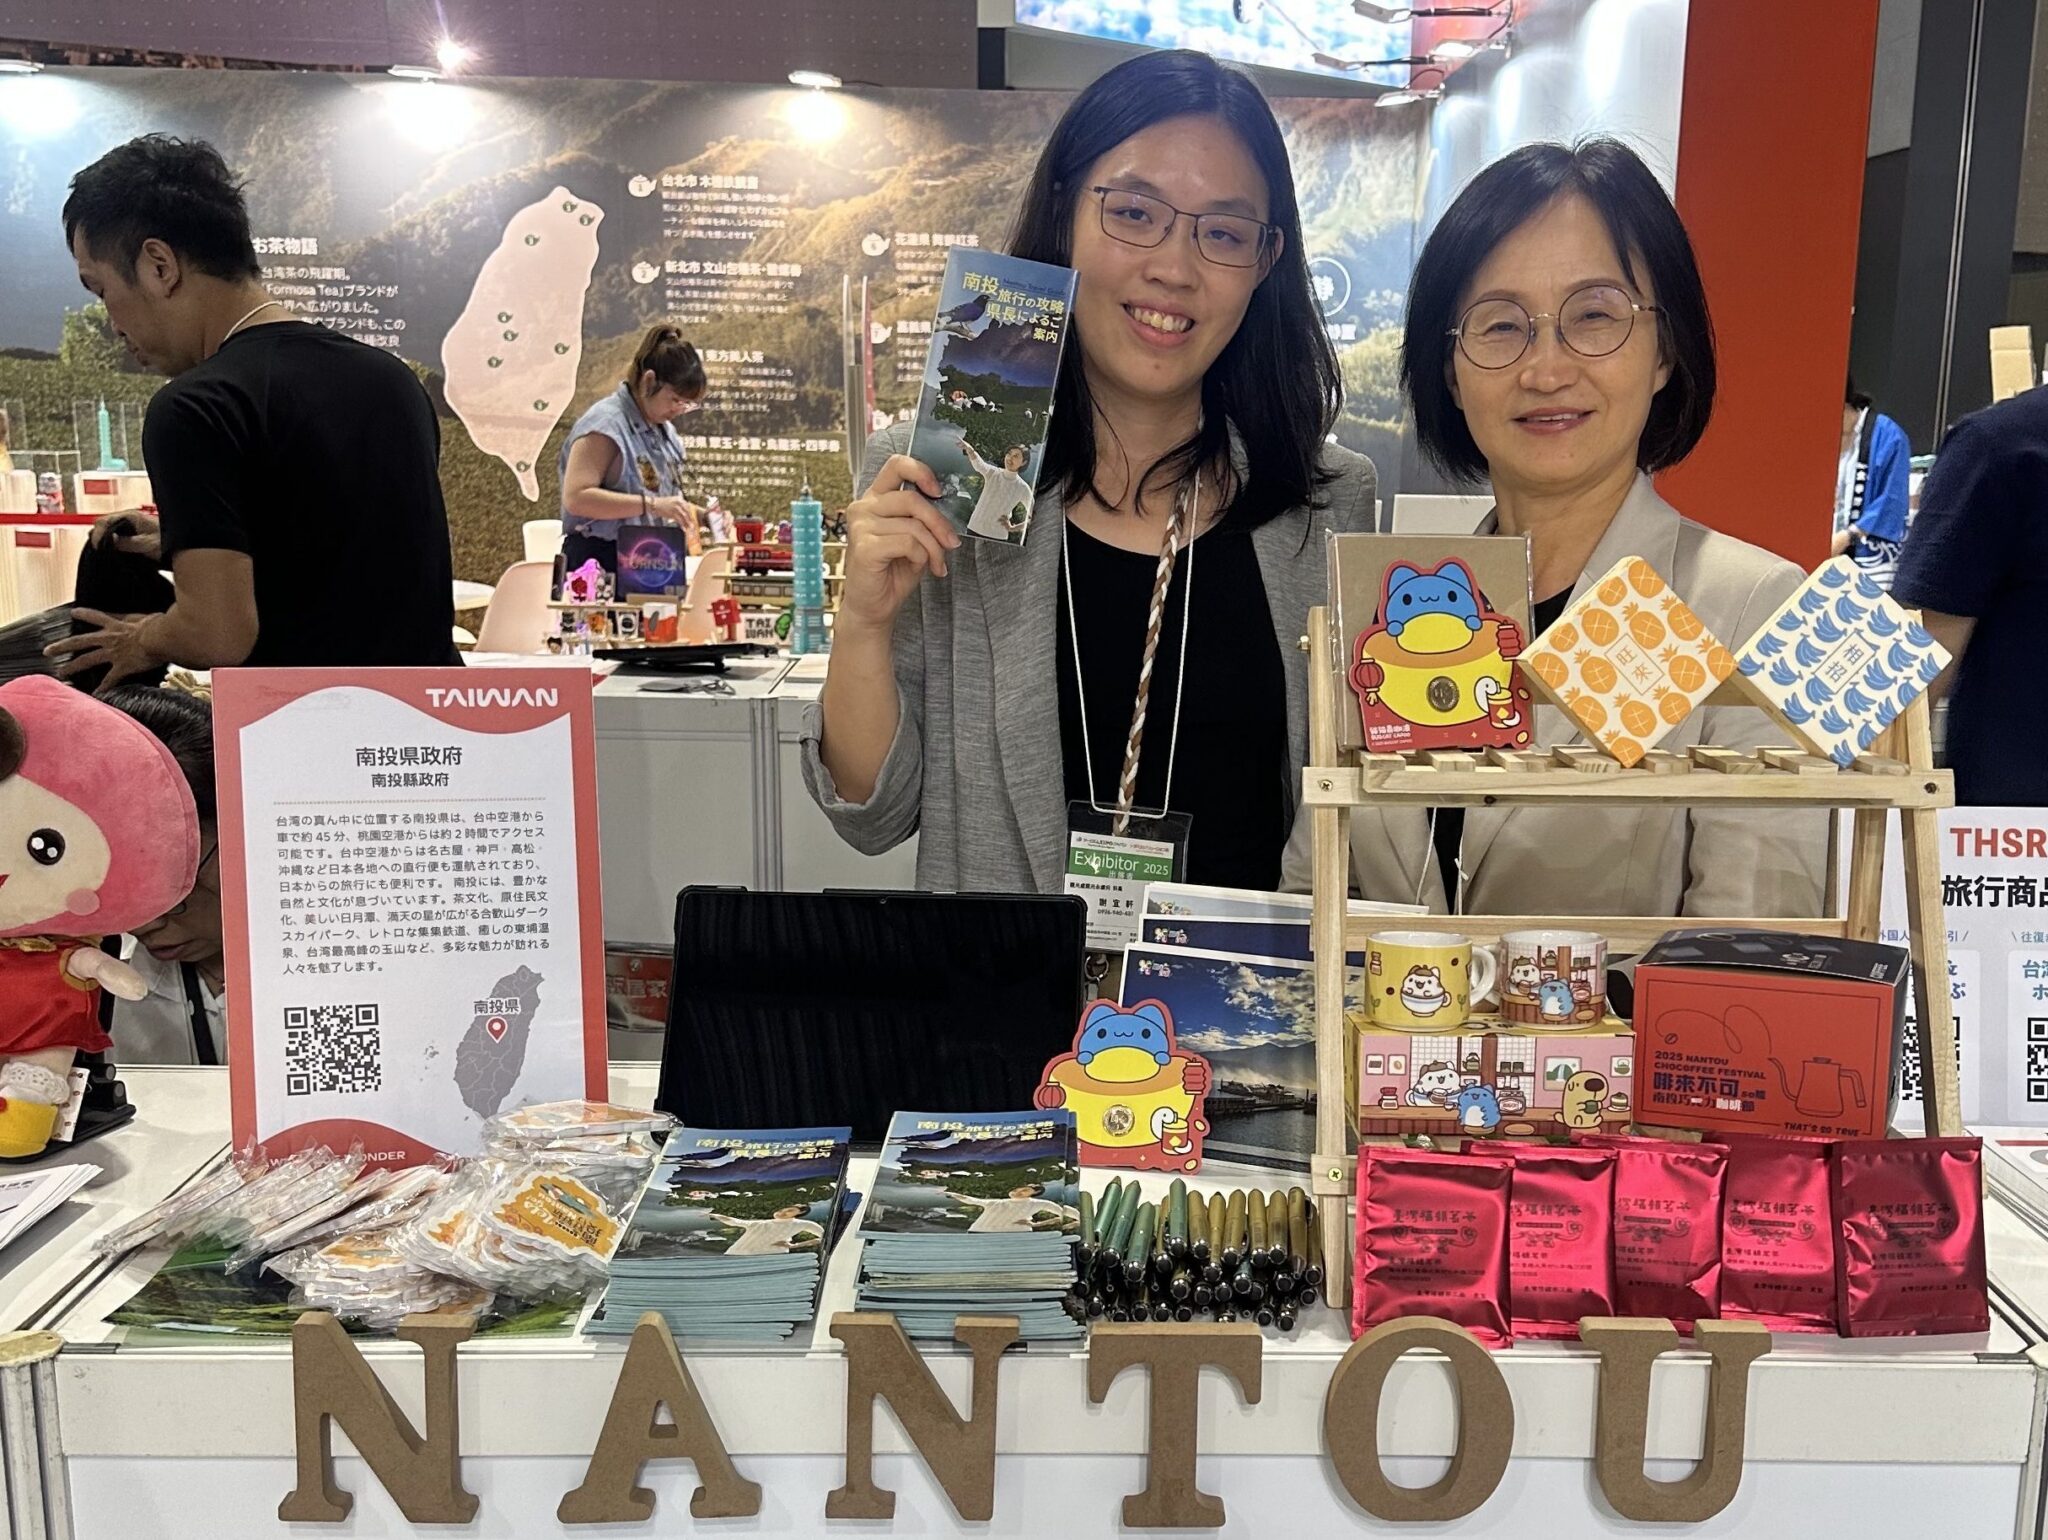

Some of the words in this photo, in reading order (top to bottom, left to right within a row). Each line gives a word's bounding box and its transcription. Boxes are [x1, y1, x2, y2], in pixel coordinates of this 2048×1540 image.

[662, 174, 698, 188] 台北市
[252, 237, 318, 255] お茶物語
[665, 260, 701, 274] 新北市
[962, 271, 999, 296] 南投
[997, 289, 1065, 315] 旅行の攻略
[276, 300, 380, 314] 界へ広がりました。
[986, 303, 1063, 329] 県長によるご
[1032, 327, 1058, 344] 案内
[425, 688, 558, 708] TAIWAN
[356, 746, 463, 767] 南投県政府
[371, 772, 450, 788] 南投縣政府
[1950, 827, 2048, 857] THSR
[1074, 850, 1140, 872] Exhibitor
[1143, 863, 1169, 876] 2025
[283, 961, 384, 975] 人々を魅了します。
[474, 998, 521, 1014] 南投県
[1655, 1050, 1683, 1060] 2025
[1686, 1055, 1729, 1066] NANTOU
[1654, 1062, 1715, 1075] CHOCOFFEE
[1718, 1068, 1767, 1079] FESTIVAL
[918, 1120, 964, 1131] 南投
[1836, 1127, 1860, 1137] TRUE
[696, 1138, 744, 1149] 南投
[278, 1311, 1772, 1528] NANTOU
